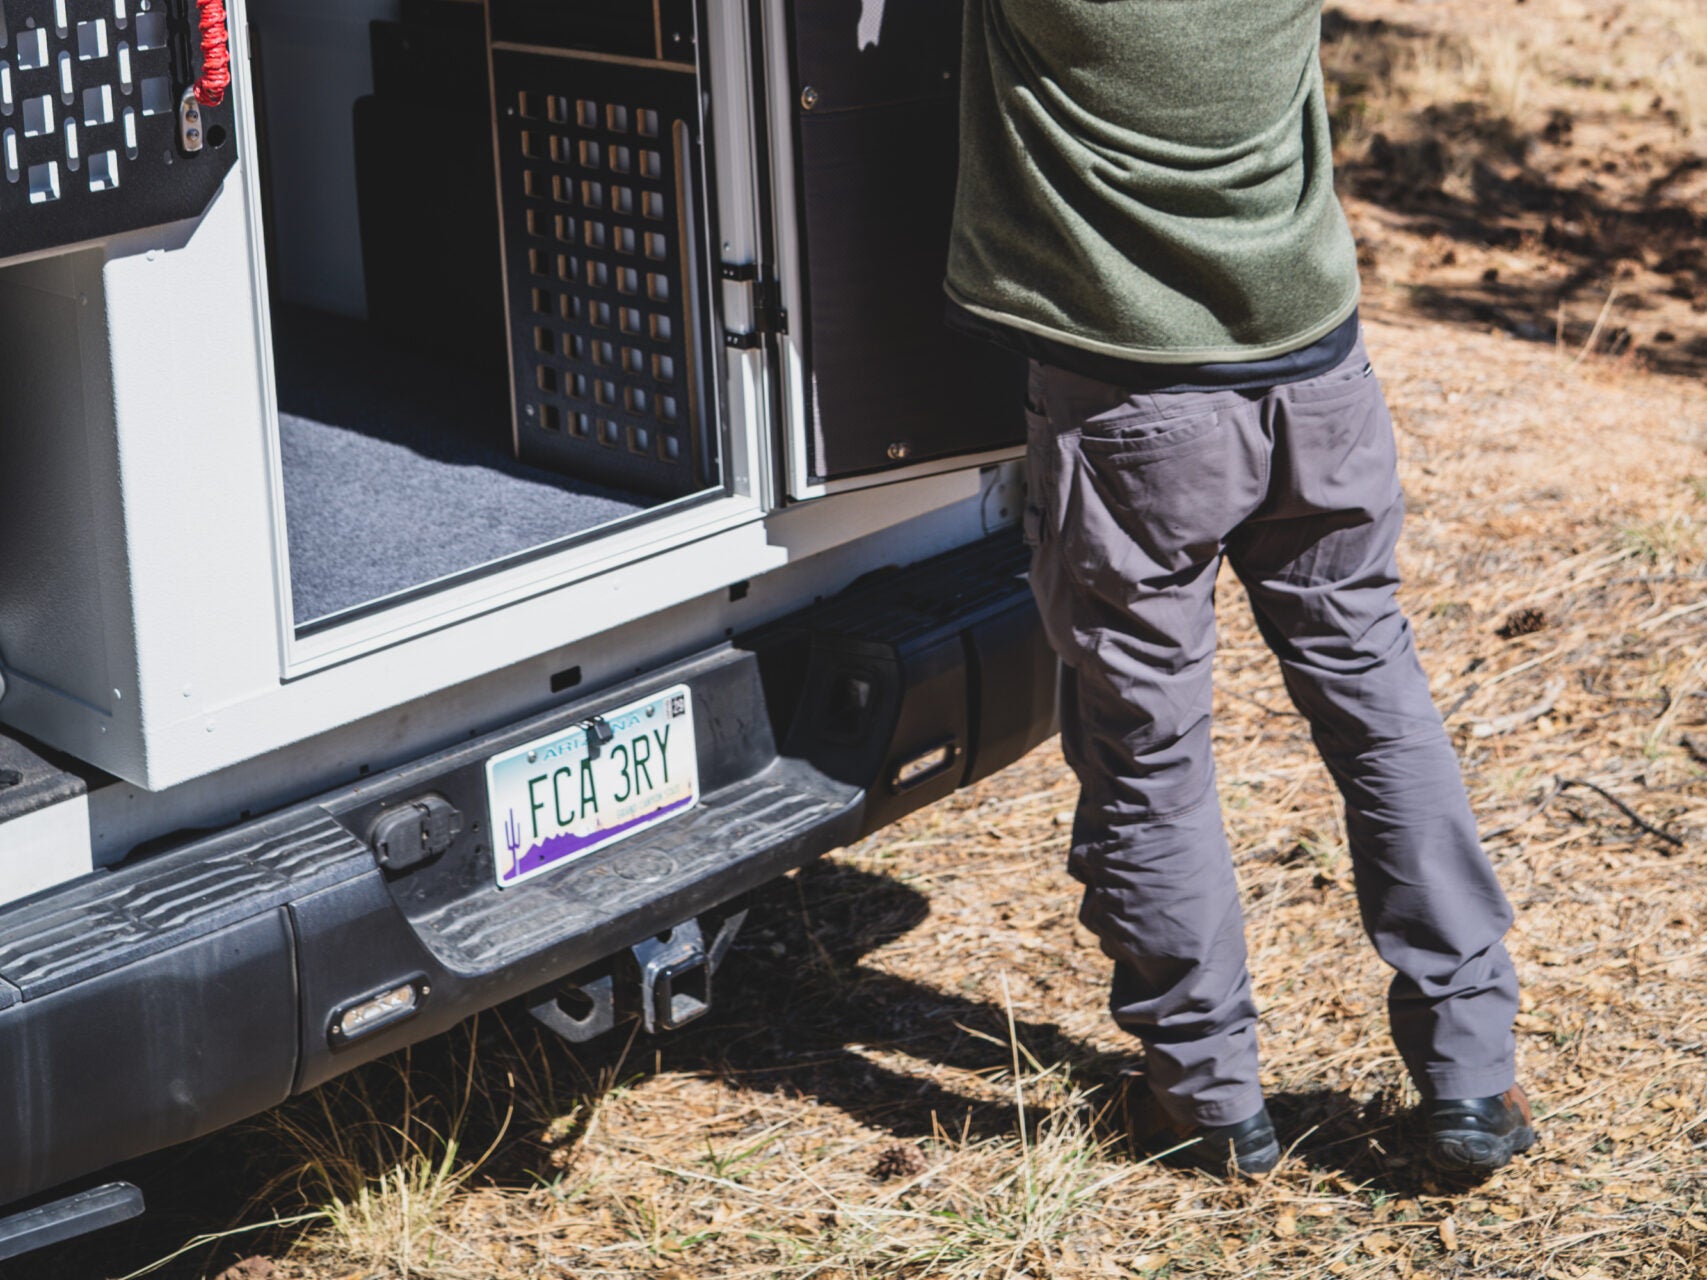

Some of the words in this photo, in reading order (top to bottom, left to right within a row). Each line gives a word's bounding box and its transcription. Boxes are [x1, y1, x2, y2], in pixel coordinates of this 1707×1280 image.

[544, 715, 640, 761] ARINA
[528, 756, 598, 839] FCA
[609, 723, 670, 803] 3RY
